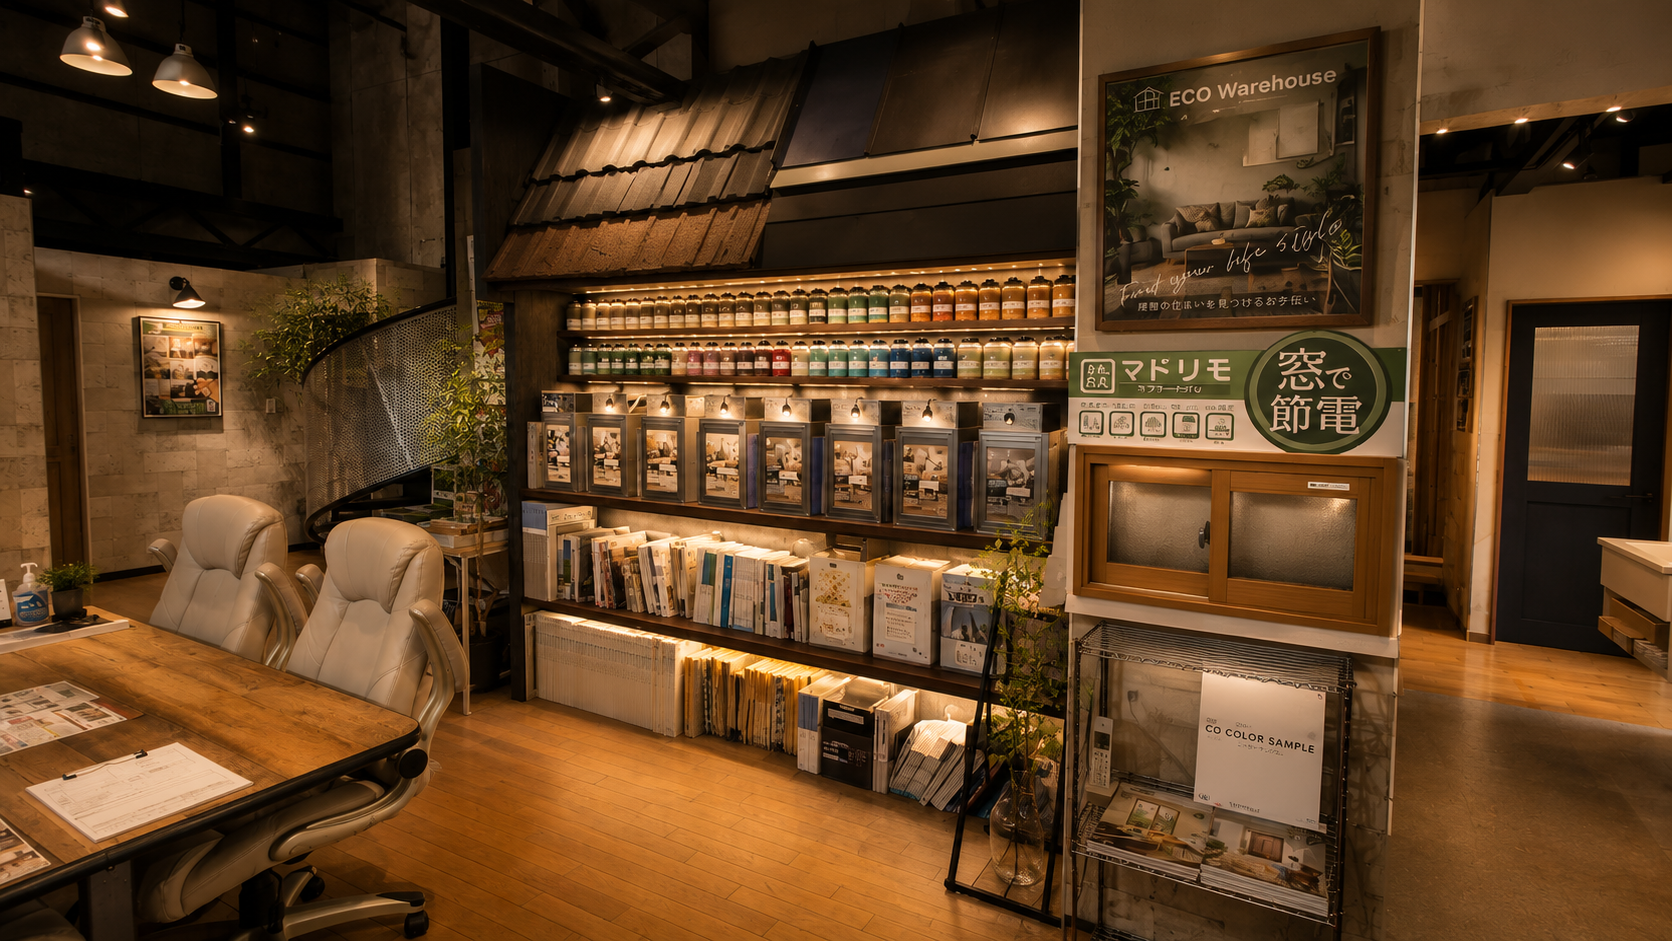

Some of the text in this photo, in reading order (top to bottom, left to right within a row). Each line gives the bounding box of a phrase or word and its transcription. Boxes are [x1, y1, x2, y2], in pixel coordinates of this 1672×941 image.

[1169, 69, 1337, 108] ECO Warehouse
[1121, 358, 1231, 382] マドリモ
[1278, 347, 1353, 391] 窓で
[1269, 394, 1363, 435] 節電
[1205, 724, 1222, 735] CO
[1225, 728, 1264, 744] COLOR
[1268, 736, 1315, 754] SAMPLE
